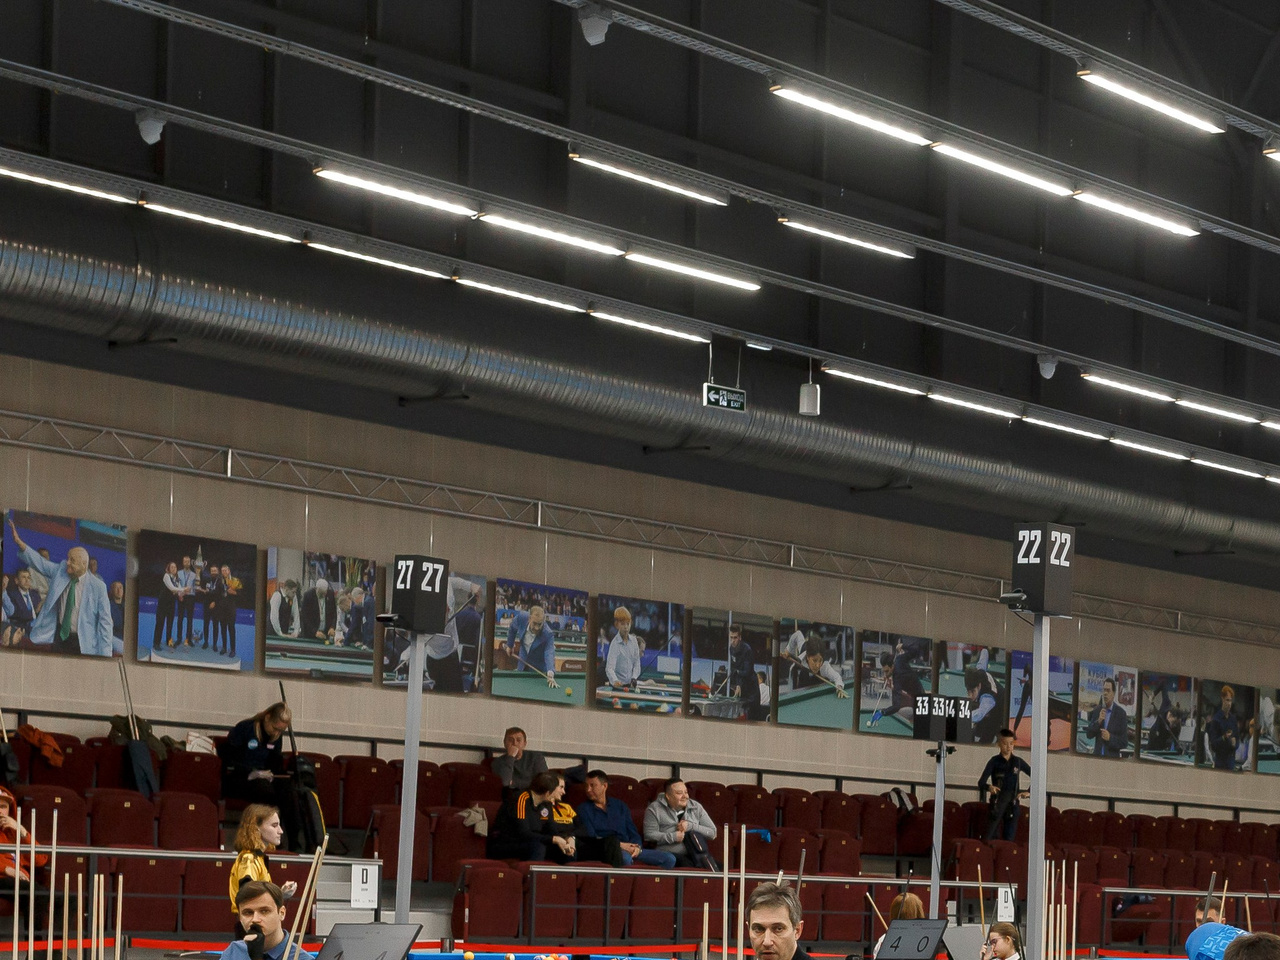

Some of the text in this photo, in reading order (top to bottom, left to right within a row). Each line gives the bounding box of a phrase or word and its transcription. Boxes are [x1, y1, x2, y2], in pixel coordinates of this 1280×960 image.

[1017, 530, 1042, 564] 22
[1050, 530, 1071, 567] 22
[396, 560, 414, 589] 27
[421, 561, 445, 593] 27
[916, 696, 929, 715] 33
[932, 697, 945, 716] 33
[959, 700, 970, 718] 34
[889, 935, 930, 953] 4 0
